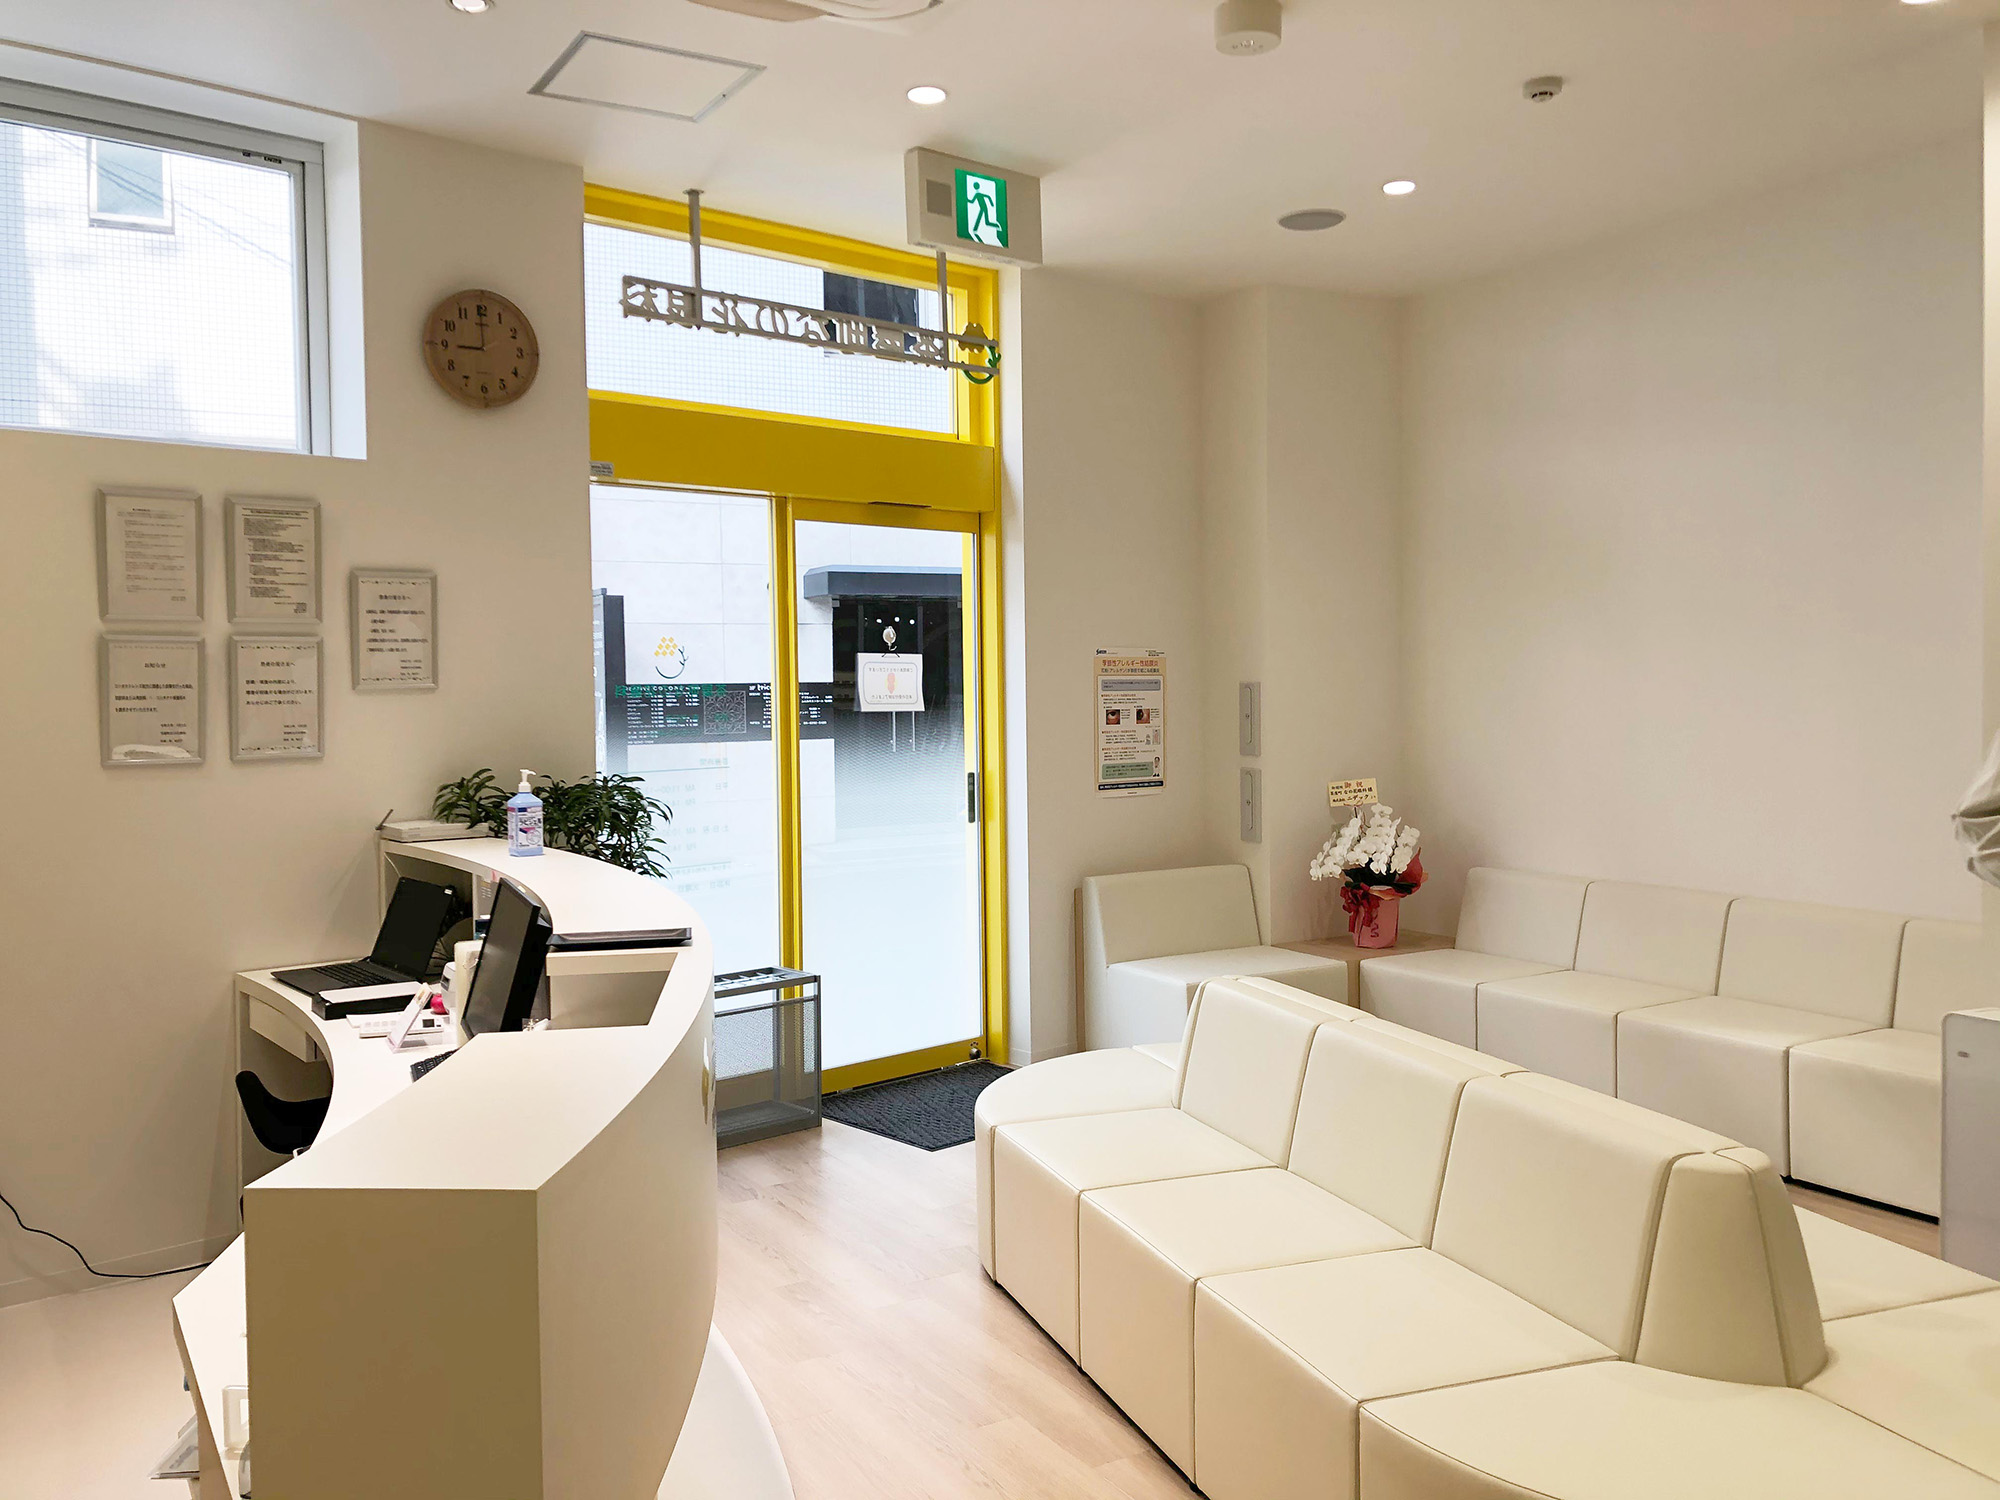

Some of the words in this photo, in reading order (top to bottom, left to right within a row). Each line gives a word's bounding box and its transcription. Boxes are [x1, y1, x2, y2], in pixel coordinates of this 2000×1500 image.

[458, 306, 468, 320] 11
[476, 304, 488, 317] 12
[497, 311, 503, 325] 1
[444, 319, 456, 332] 10
[509, 327, 518, 340] 2
[441, 339, 449, 350] 9
[516, 347, 525, 359] 3
[447, 359, 455, 371] 8
[511, 366, 519, 378] 4
[481, 384, 488, 394] 6
[499, 378, 506, 391] 5
